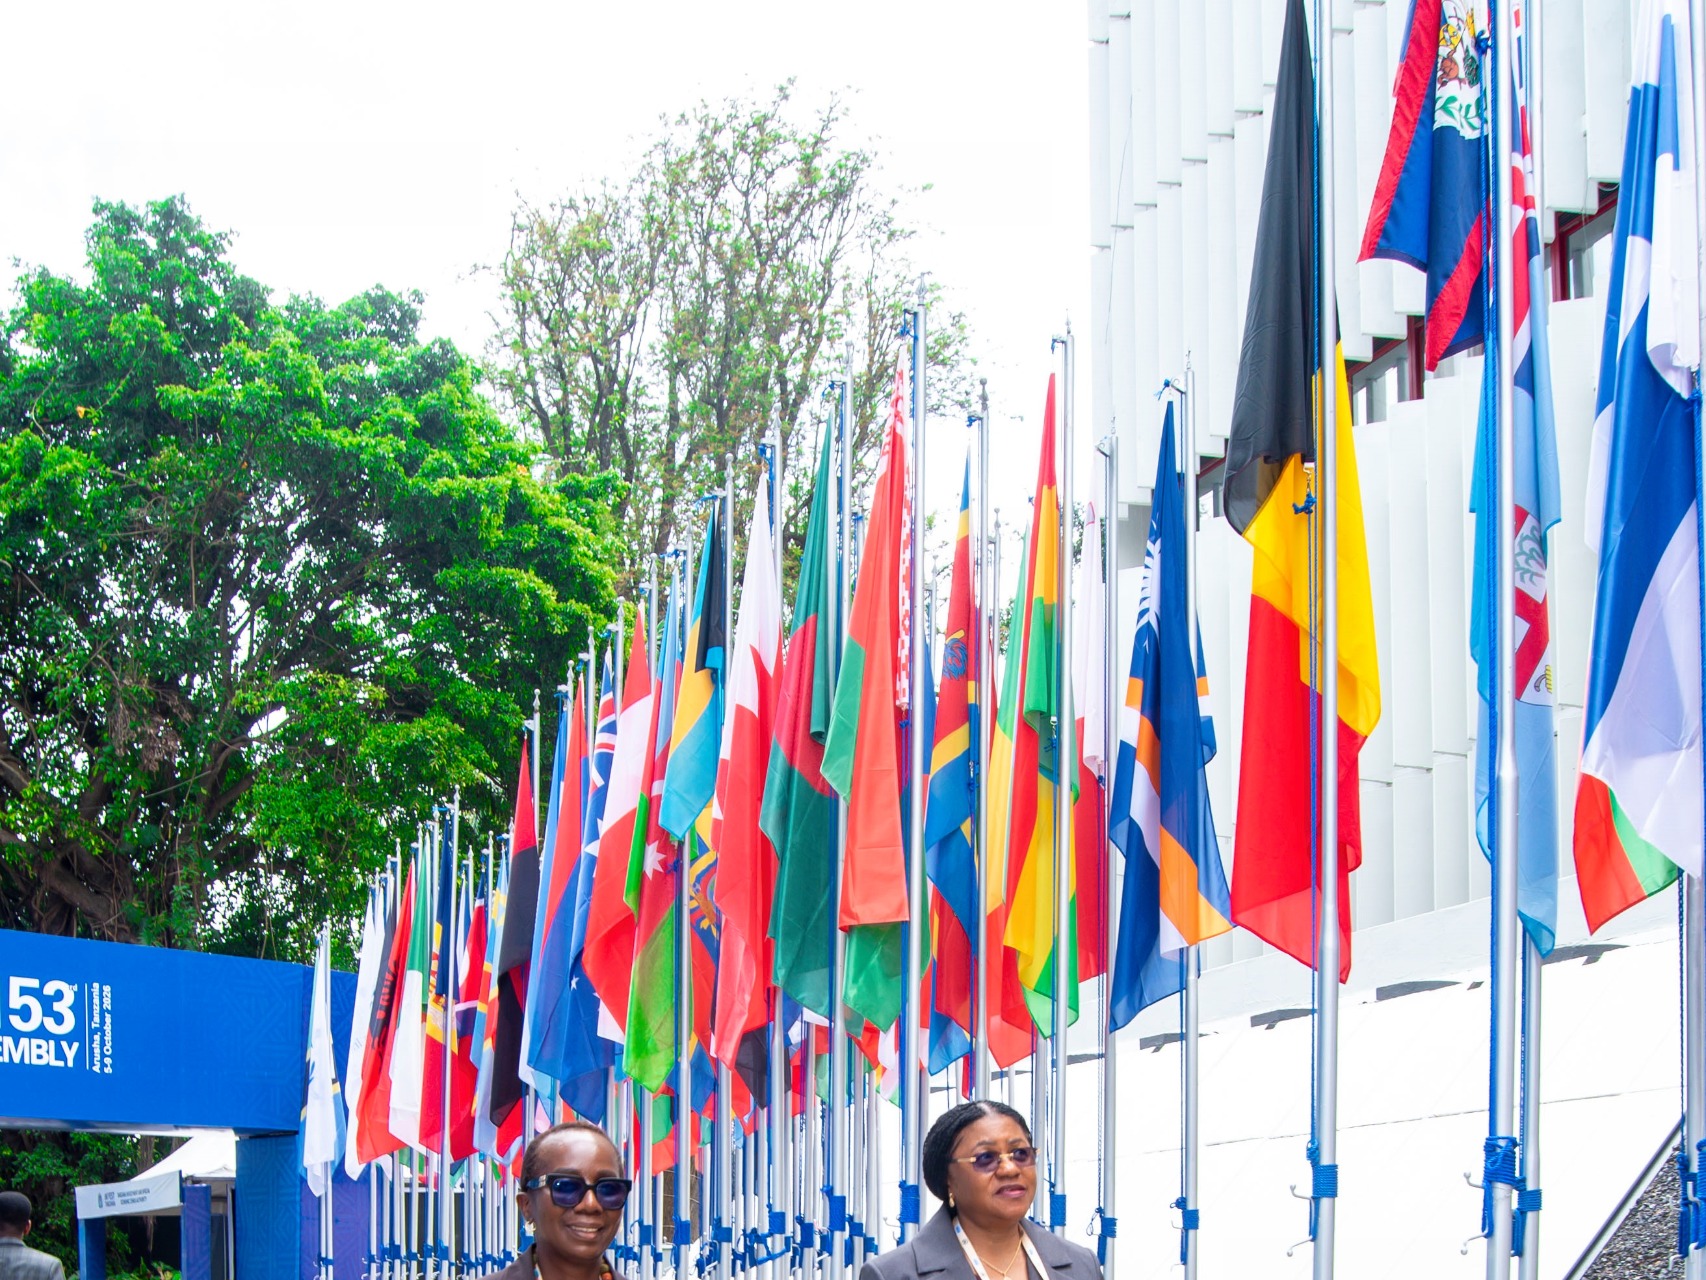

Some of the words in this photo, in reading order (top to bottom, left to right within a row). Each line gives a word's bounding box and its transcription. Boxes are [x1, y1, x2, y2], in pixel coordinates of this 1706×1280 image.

[91, 982, 100, 1029] Tanzania
[102, 984, 111, 1011] 2026
[0, 1035, 80, 1068] MBLY
[91, 1031, 101, 1073] Arusha,
[103, 1012, 112, 1055] October
[103, 1057, 112, 1074] 5-9
